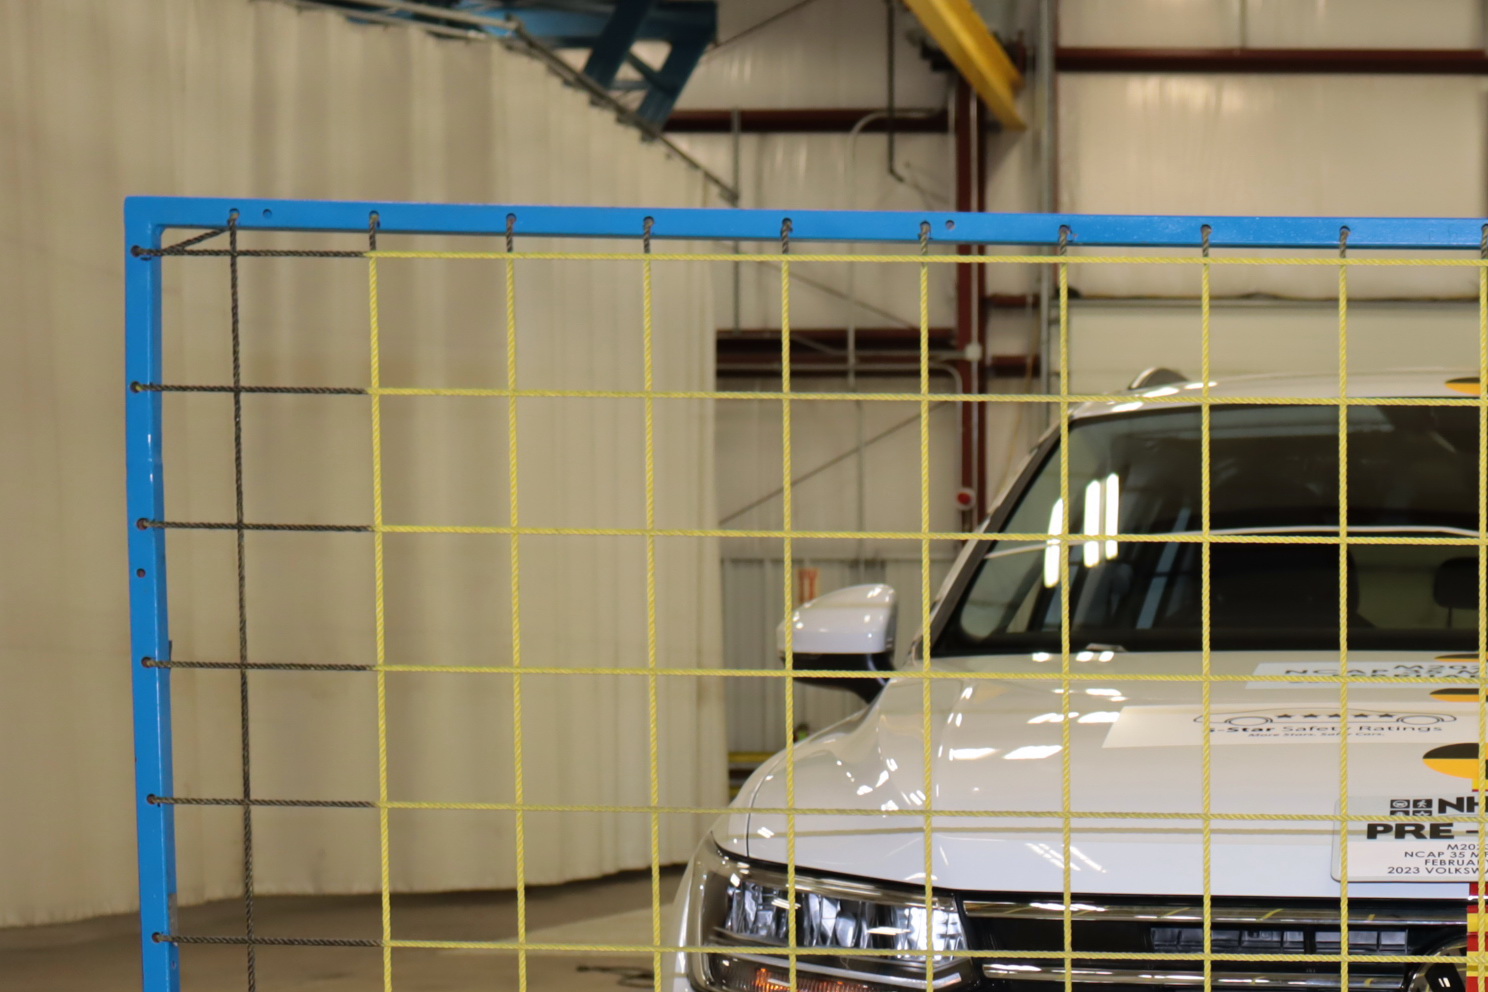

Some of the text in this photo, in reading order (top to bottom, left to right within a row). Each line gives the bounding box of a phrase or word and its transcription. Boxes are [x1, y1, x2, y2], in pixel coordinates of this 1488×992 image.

[1358, 725, 1443, 733] Ratings
[1366, 822, 1455, 840] PRE
[1387, 866, 1421, 874] 2023
